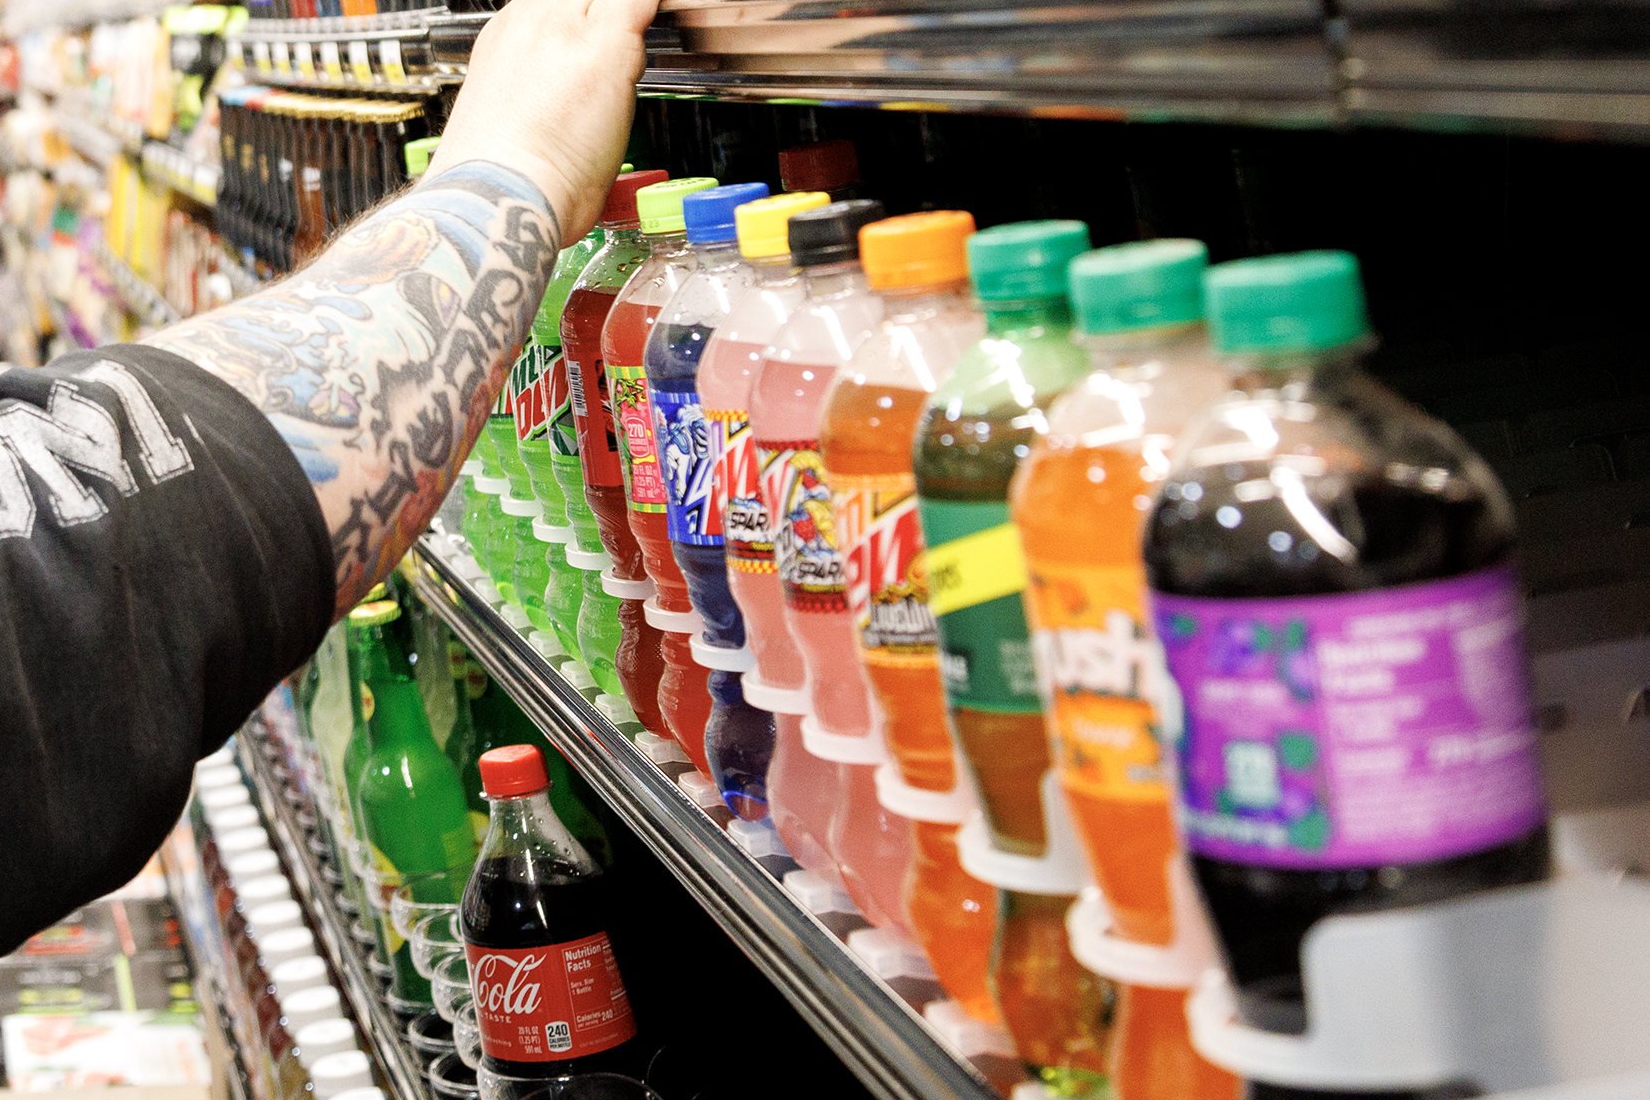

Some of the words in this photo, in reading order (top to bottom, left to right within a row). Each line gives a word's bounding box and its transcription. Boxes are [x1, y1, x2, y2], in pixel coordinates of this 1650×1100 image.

[628, 423, 644, 438] 270
[730, 510, 770, 531] SPAR
[799, 561, 842, 579] SPAR
[565, 944, 601, 961] Nutrition
[567, 959, 592, 973] Facts
[474, 954, 547, 1014] Cola
[576, 1011, 601, 1023] Calories
[601, 1009, 614, 1022] 240
[547, 1023, 568, 1038] 240
